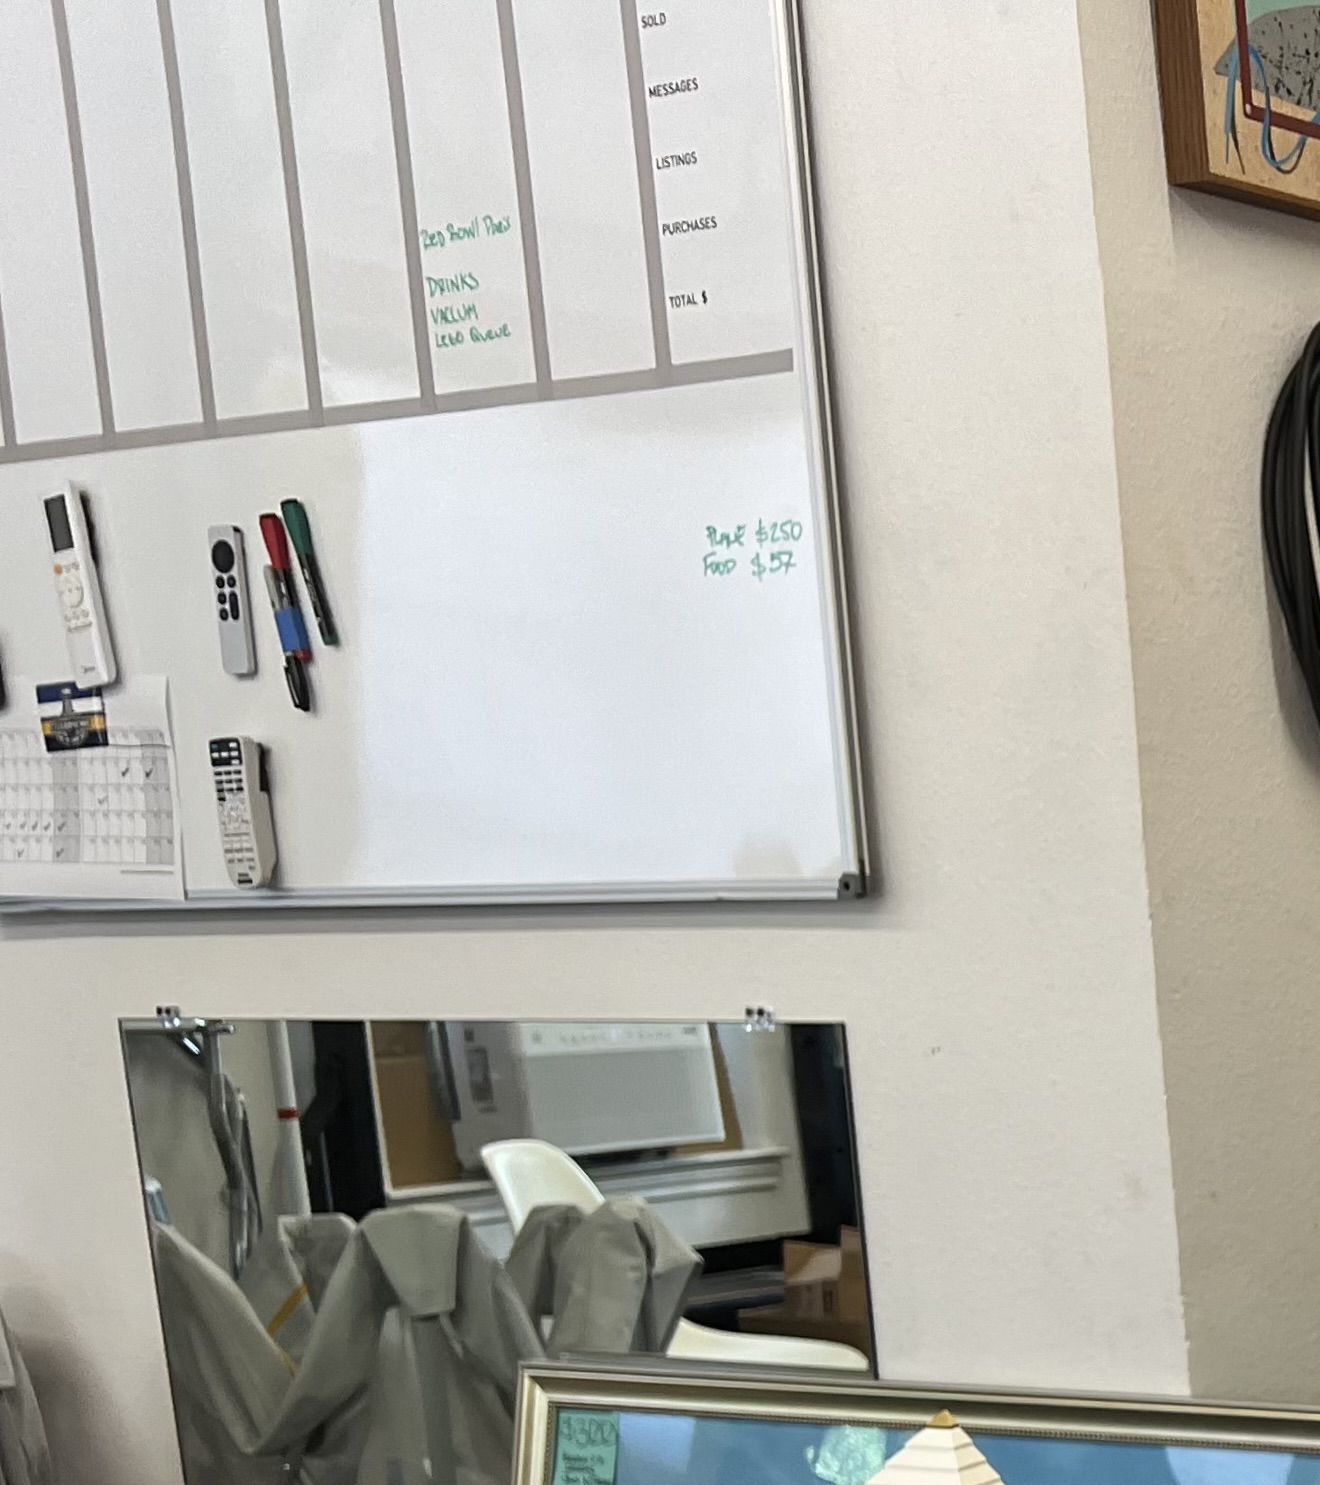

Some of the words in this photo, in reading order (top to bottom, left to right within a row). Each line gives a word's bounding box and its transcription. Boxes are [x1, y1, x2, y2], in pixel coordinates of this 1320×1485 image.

[641, 12, 667, 29] SOLD
[648, 77, 699, 99] MESSAGES
[655, 151, 698, 170] LISTINGS
[661, 216, 718, 237] PURCHASES
[425, 271, 480, 298] DRINKS
[669, 293, 698, 309] TOTAL
[701, 290, 708, 304] $
[755, 518, 802, 548] $250
[751, 552, 797, 582] $57
